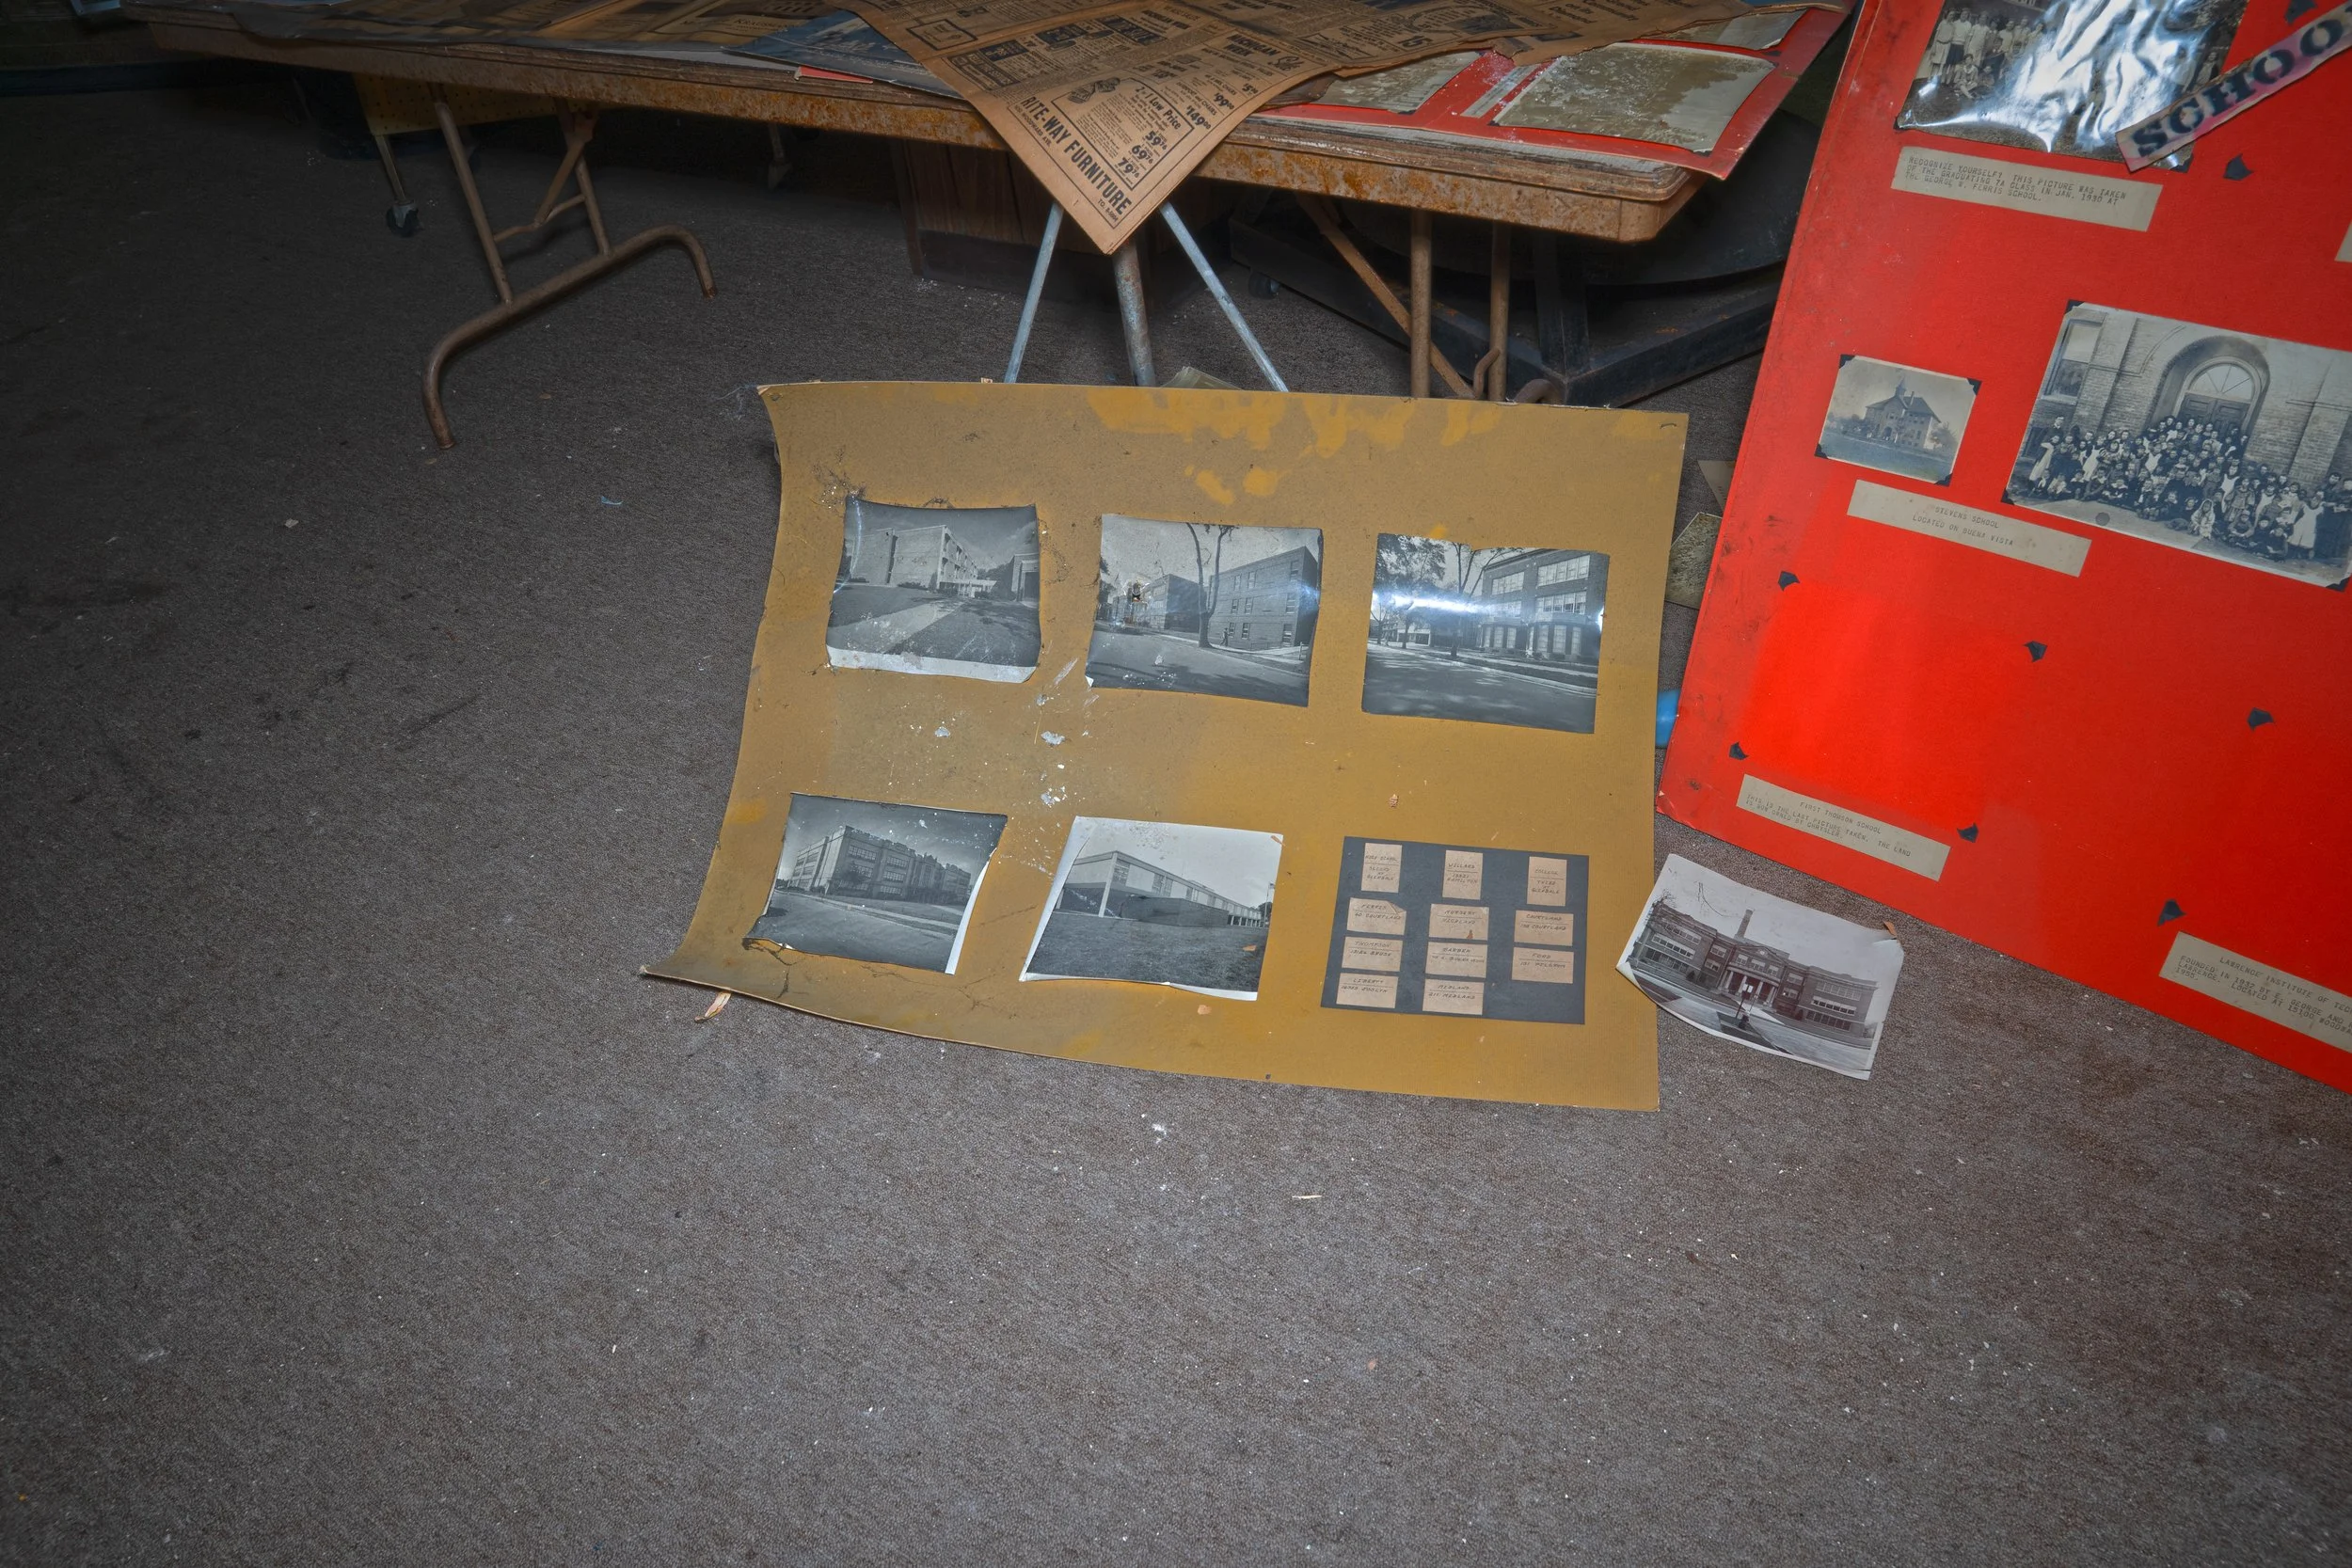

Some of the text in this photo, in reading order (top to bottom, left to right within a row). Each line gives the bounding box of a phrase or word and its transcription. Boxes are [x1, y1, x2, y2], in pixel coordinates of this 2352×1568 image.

[2132, 5, 2352, 158] SCHOO
[1150, 96, 1165, 111] Low
[1163, 108, 1182, 130] Price
[1020, 96, 1071, 144] RITE-WAY
[1064, 139, 1132, 215] FURNITURE
[1905, 171, 1918, 181] THE
[1924, 175, 1953, 188] GEORGE
[1972, 183, 2003, 195] FERRIS
[2008, 188, 2042, 202] SCHOOL.
[1908, 157, 2126, 200] RECOGNIZE YOURSELF? THIS PICTURE WAS TAKEN
[1922, 166, 1935, 175] THE
[1941, 169, 1990, 185] GRADUATING
[2010, 182, 2035, 193] CLASS
[2056, 189, 2075, 200] JAN.
[2081, 193, 2103, 204] 1930
[2107, 198, 2119, 206] AT
[1913, 514, 2013, 546] LOCATED ON BUENA VISTA
[1934, 506, 1999, 529] STEVENS SCHOOL
[1746, 794, 1762, 804] THIS
[1777, 805, 1789, 815] THE
[1792, 811, 1810, 821] LAST
[1813, 818, 1841, 833] PICTURE
[1877, 840, 1891, 850] THE
[1893, 846, 1912, 858] LAND
[1756, 803, 1769, 813] NOW
[1772, 809, 1791, 821] OWNED
[1806, 822, 1843, 839] CHRYSLER.
[1799, 801, 1820, 814] FIRST
[1856, 820, 1882, 835] SCHOOL
[2178, 960, 2221, 984] LAWRENCE.
[2231, 982, 2267, 1001] LOCATED
[2272, 998, 2283, 1007] AT
[2287, 1004, 2315, 1020] 15100
[2180, 955, 2216, 974] FOUNDED
[2220, 971, 2230, 979] IN
[2234, 976, 2256, 990] 1932
[2259, 987, 2271, 995] BY
[2290, 999, 2323, 1016] GEORGE
[2328, 1013, 2344, 1024] AND
[2219, 957, 2260, 978] LAWRENCE
[2265, 974, 2313, 998] INSTITUTE
[2317, 995, 2330, 1004] OF
